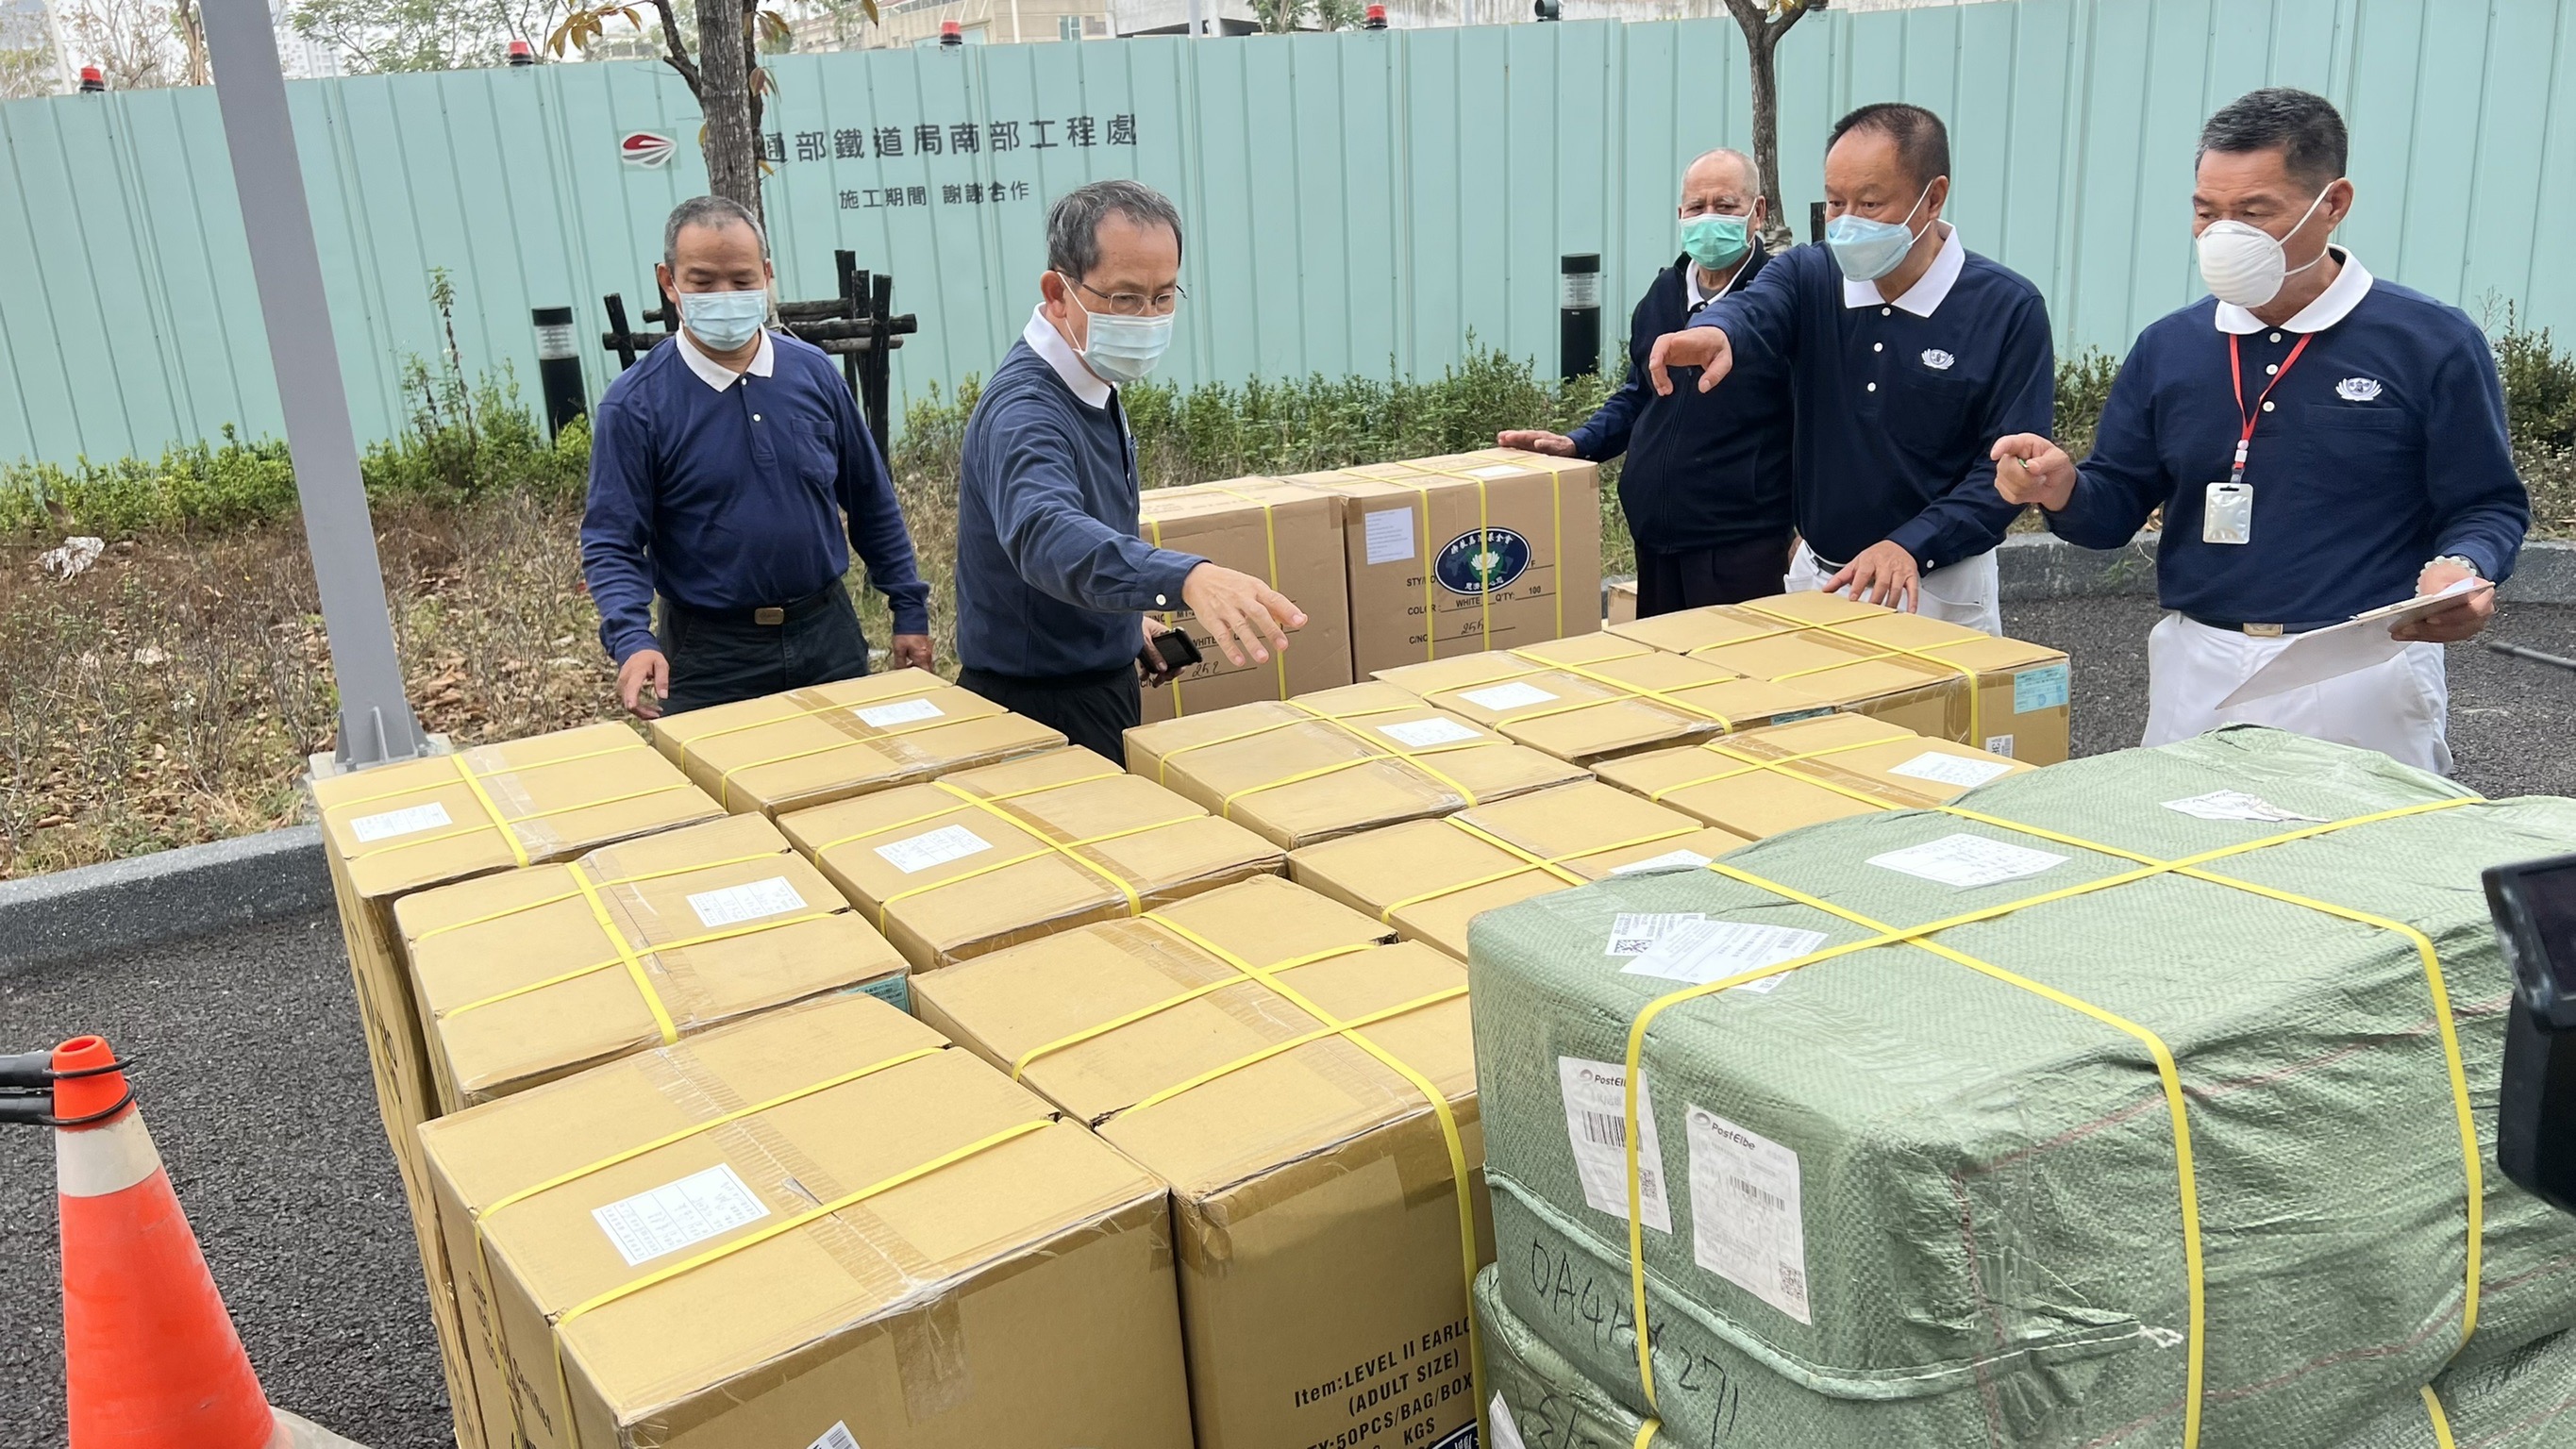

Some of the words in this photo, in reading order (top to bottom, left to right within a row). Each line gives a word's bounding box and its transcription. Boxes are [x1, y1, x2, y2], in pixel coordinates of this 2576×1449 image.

[839, 186, 927, 209] 施工期間
[942, 180, 1029, 205] 謝謝合作
[1455, 596, 1480, 608] WHITE
[1529, 586, 1542, 595] 100
[1711, 1122, 1756, 1150] PostElbe
[1295, 1351, 1397, 1407] Item:LEVEL
[1348, 1374, 1410, 1417] (ADULT
[1416, 1348, 1460, 1383] SIZE)
[1403, 1416, 1435, 1446] KGS
